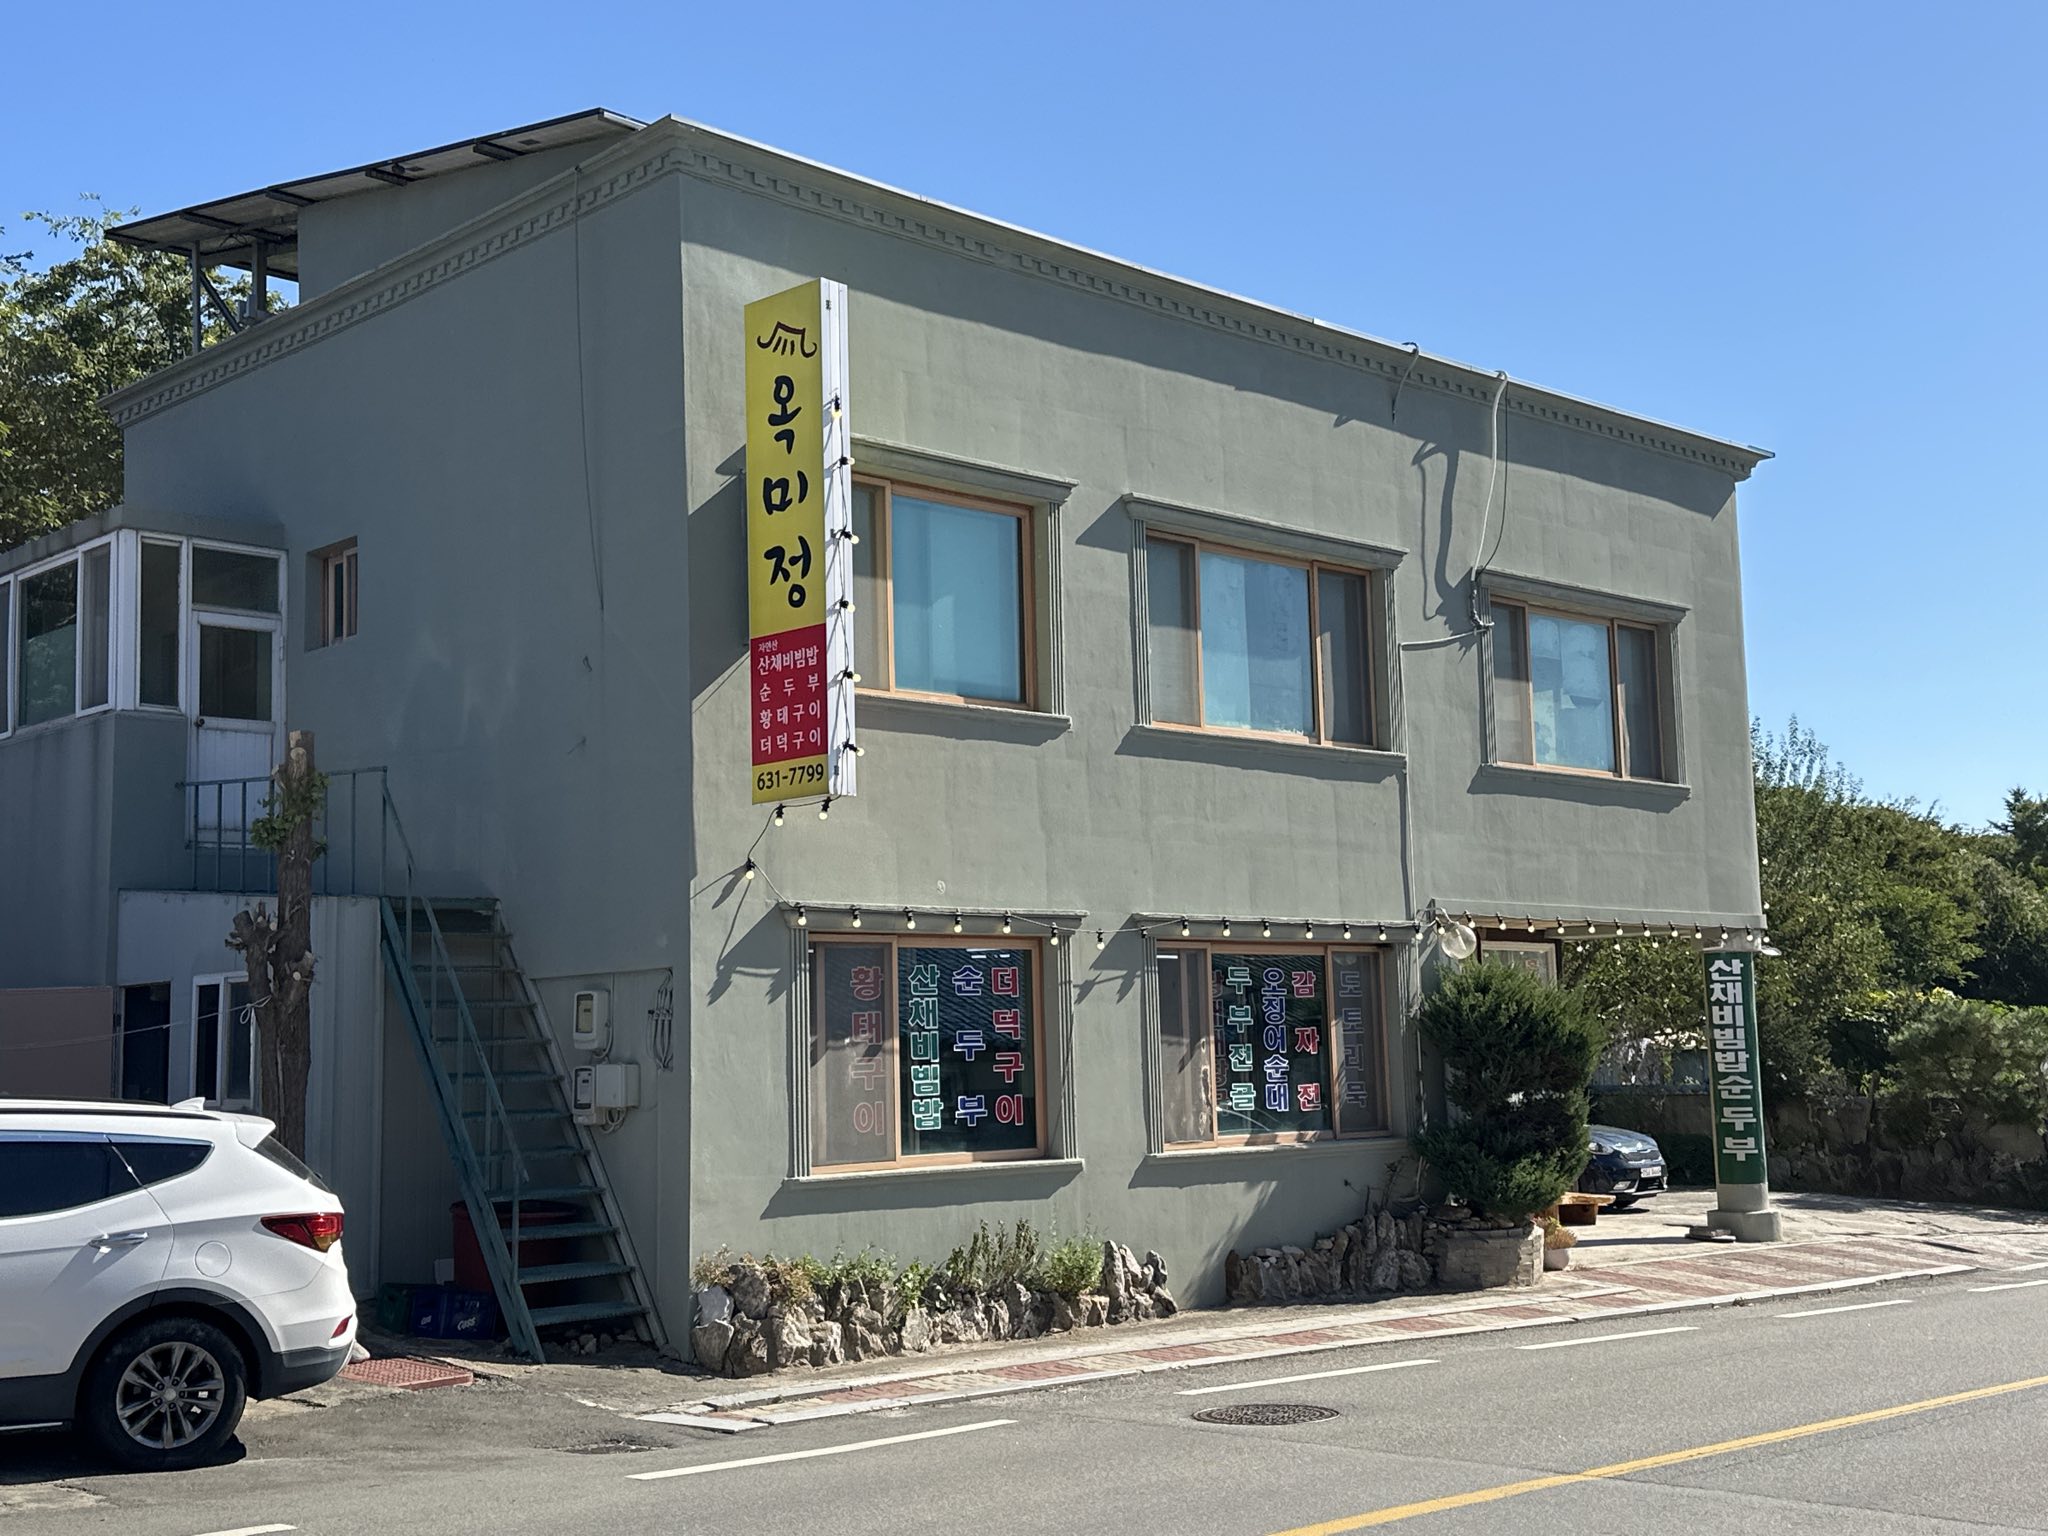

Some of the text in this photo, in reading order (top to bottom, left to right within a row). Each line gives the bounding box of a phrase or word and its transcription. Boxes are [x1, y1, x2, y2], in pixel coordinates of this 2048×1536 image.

[762, 375, 812, 608] 옥미정
[757, 645, 820, 676] 산채비빔밥
[760, 699, 820, 729] 황태구이
[757, 763, 824, 791] 631-7799
[760, 727, 820, 755] 더덕구이
[851, 965, 885, 1136] 황태구이
[908, 964, 944, 1131] 산채비빔밥
[952, 965, 988, 1127] 순두부
[991, 967, 1024, 1126] 더덕구이
[1226, 967, 1256, 1112] 두부전골
[1261, 967, 1289, 1112] 오징어순대
[1291, 970, 1322, 1112] 감자전
